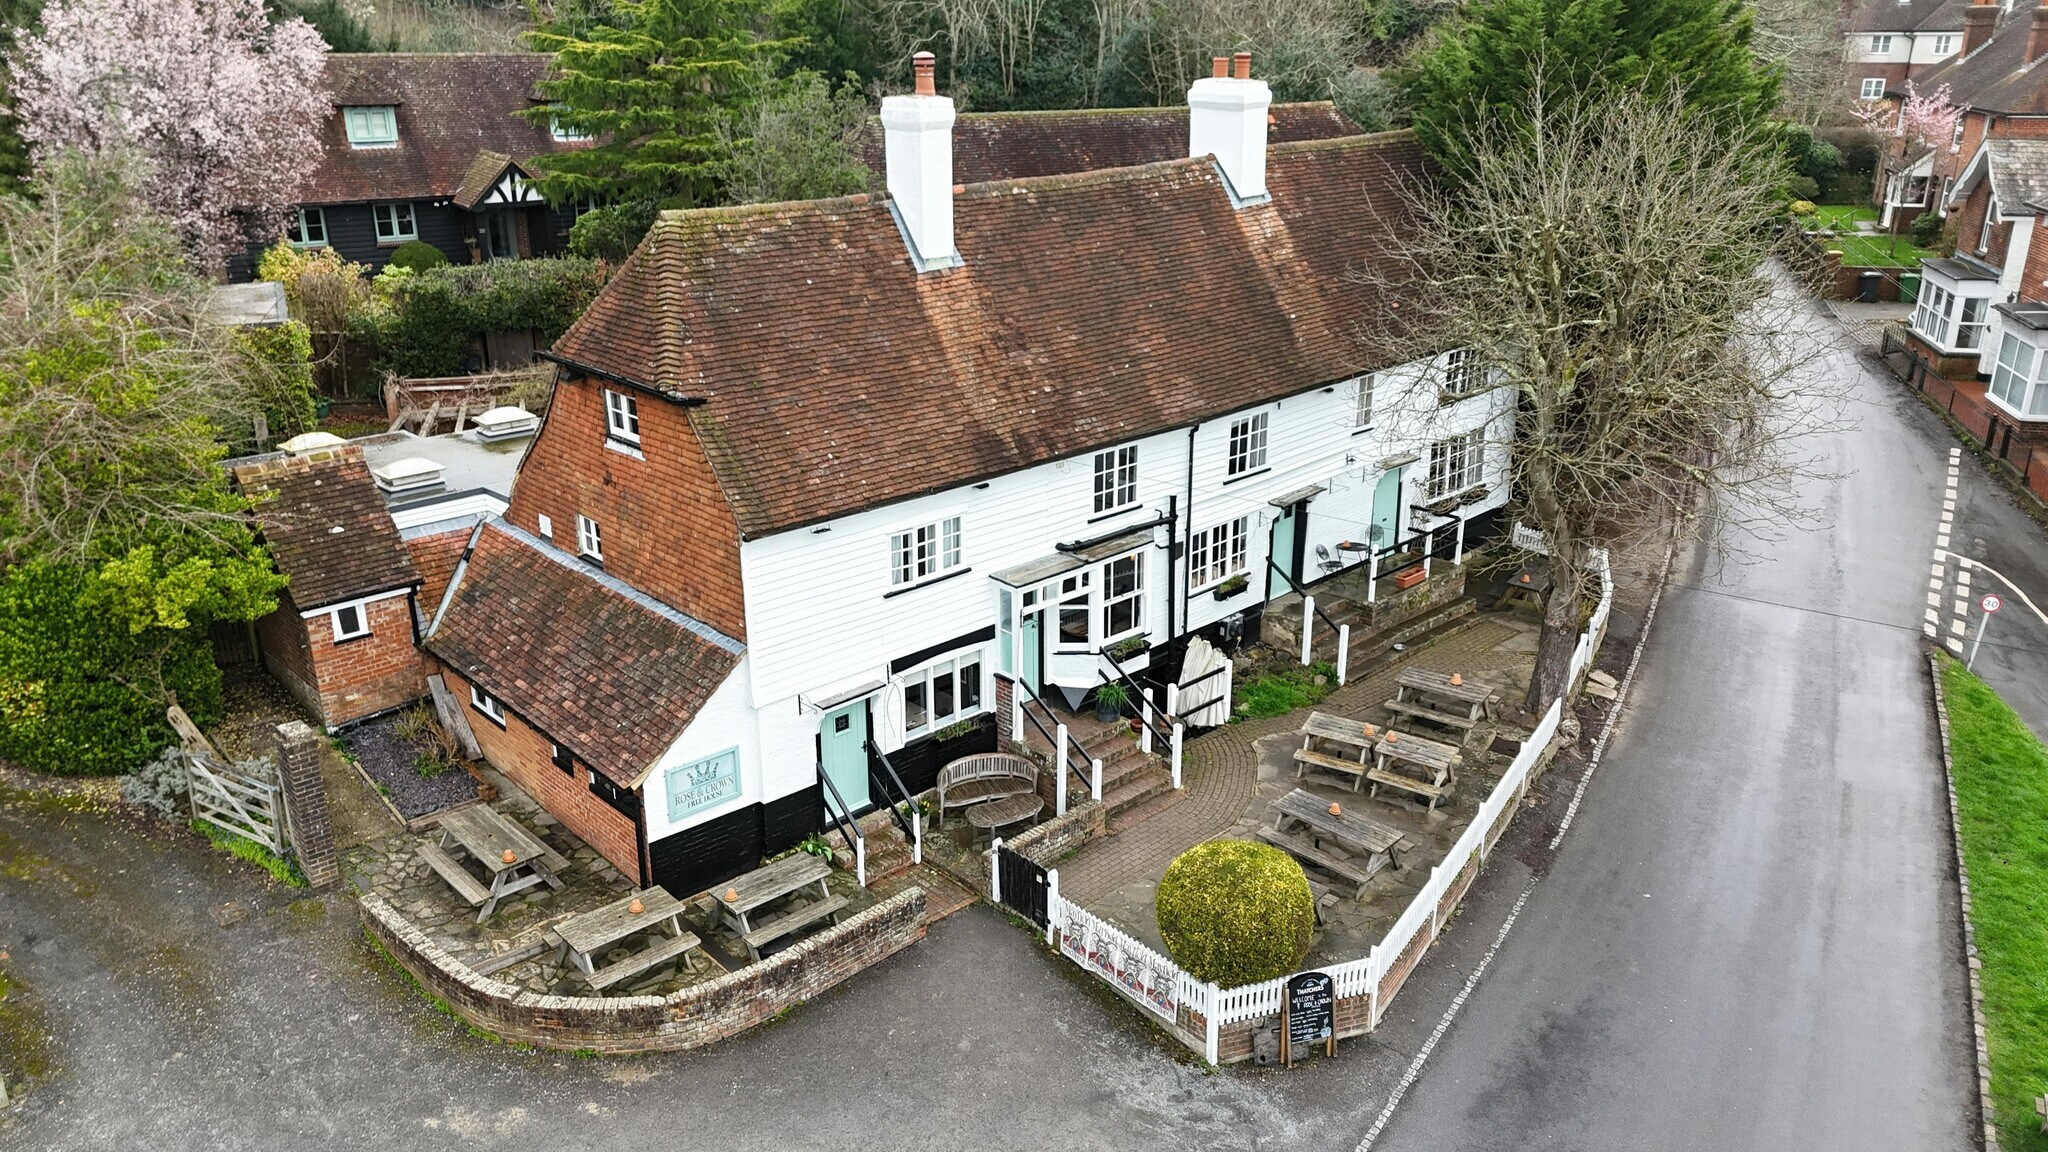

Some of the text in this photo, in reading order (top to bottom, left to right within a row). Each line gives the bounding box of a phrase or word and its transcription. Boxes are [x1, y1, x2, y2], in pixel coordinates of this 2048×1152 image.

[1984, 599, 1998, 608] 30
[674, 776, 735, 806] ROSE & CROWN
[687, 791, 723, 808] FREE HOUSE
[1297, 986, 1324, 994] THATCHERS
[1292, 994, 1314, 1004] WELCOME
